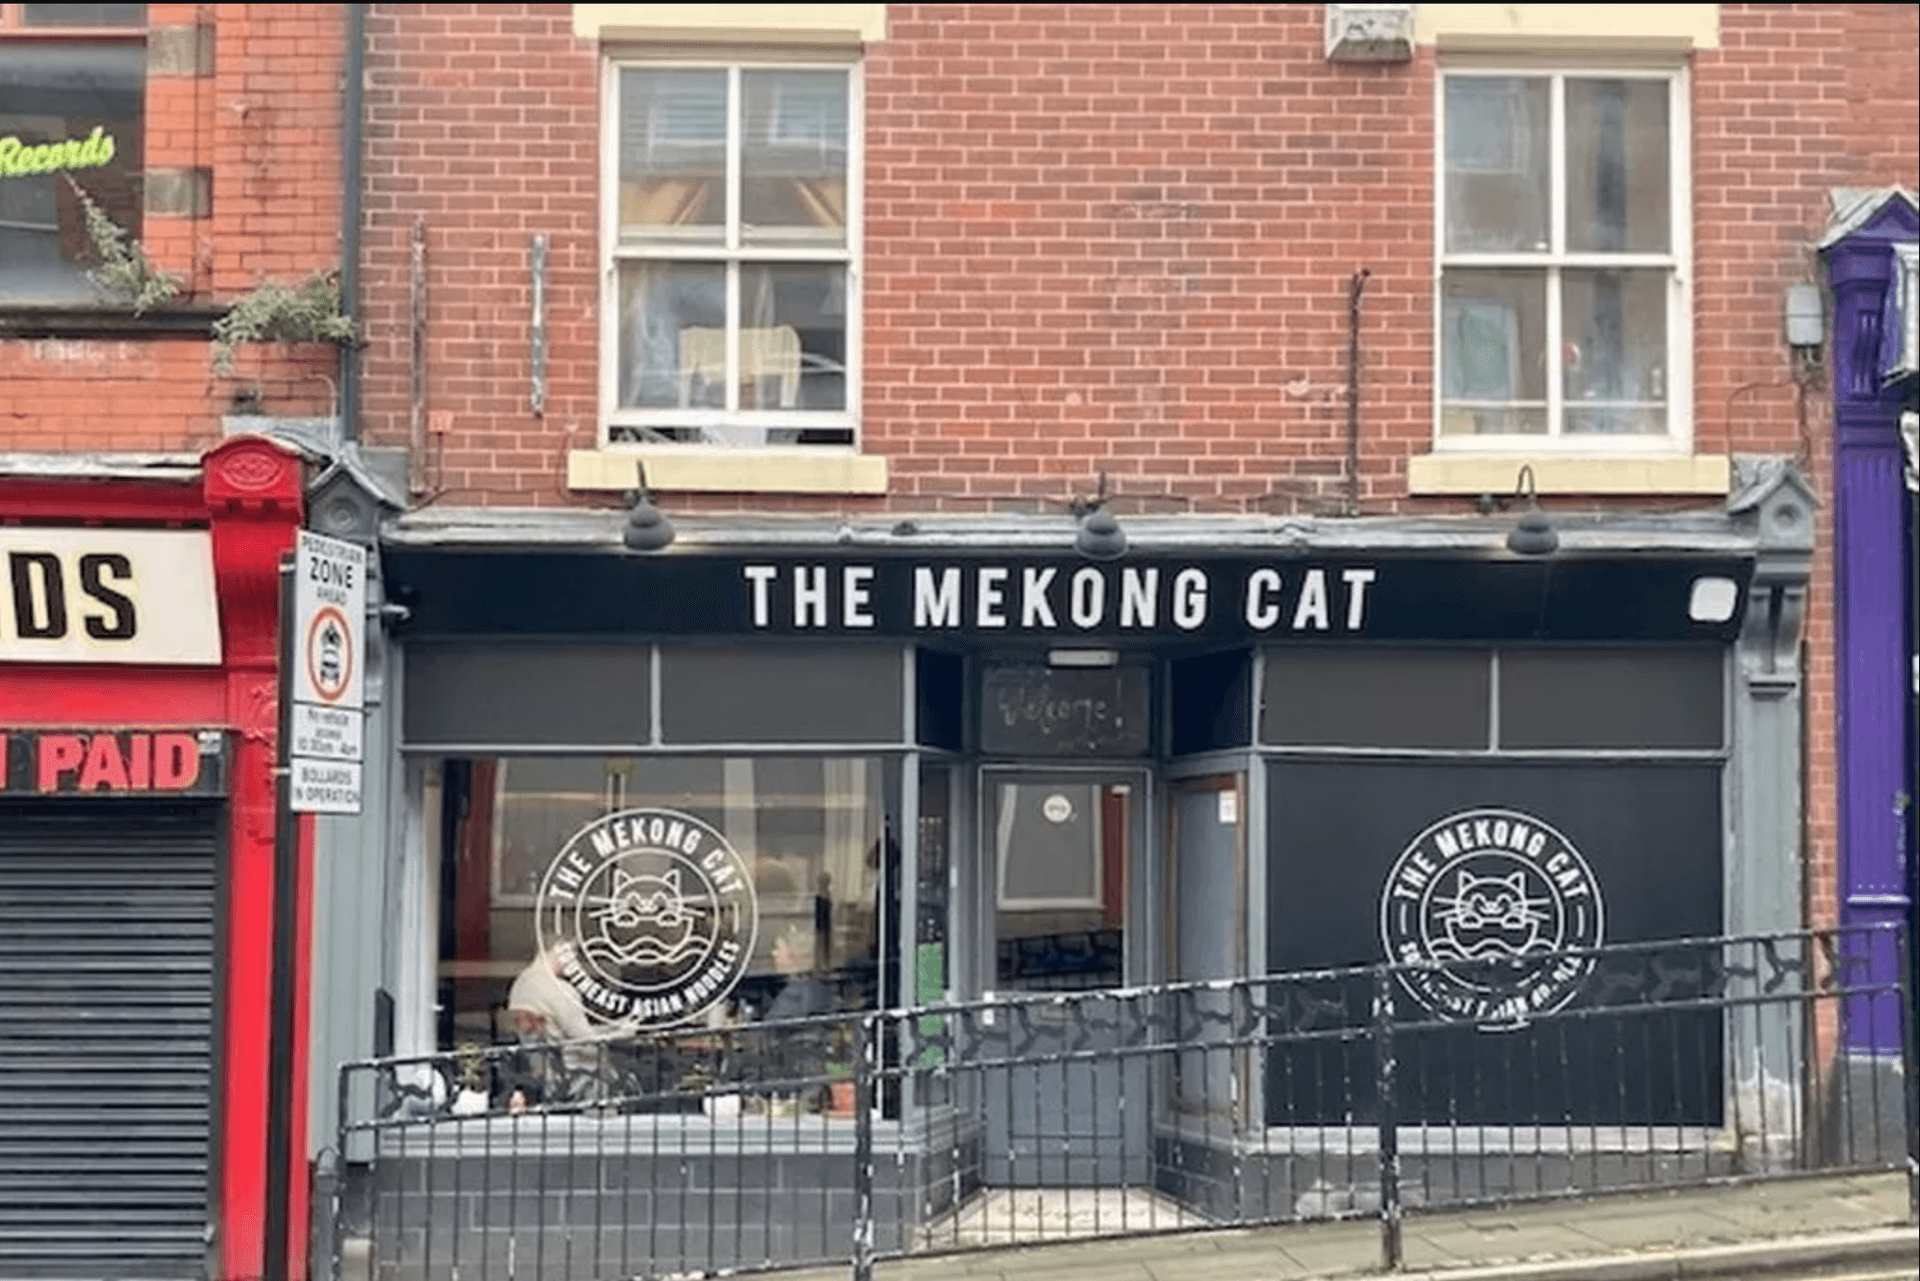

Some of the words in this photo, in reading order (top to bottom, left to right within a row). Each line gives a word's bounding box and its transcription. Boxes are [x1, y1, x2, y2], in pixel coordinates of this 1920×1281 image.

[310, 556, 353, 589] ZONE
[744, 566, 875, 628] THE
[913, 567, 1209, 629] MEKONG
[1245, 568, 1376, 630] CAT
[39, 734, 199, 790] PAID
[549, 851, 593, 900] THE
[591, 818, 701, 858] MEKONG
[702, 848, 744, 894] CAT
[1393, 851, 1438, 900] THE
[1434, 820, 1546, 858] MEKONG
[1546, 852, 1589, 898] CAT
[632, 994, 683, 1017] ASIAN
[683, 940, 741, 1005] NOODLES
